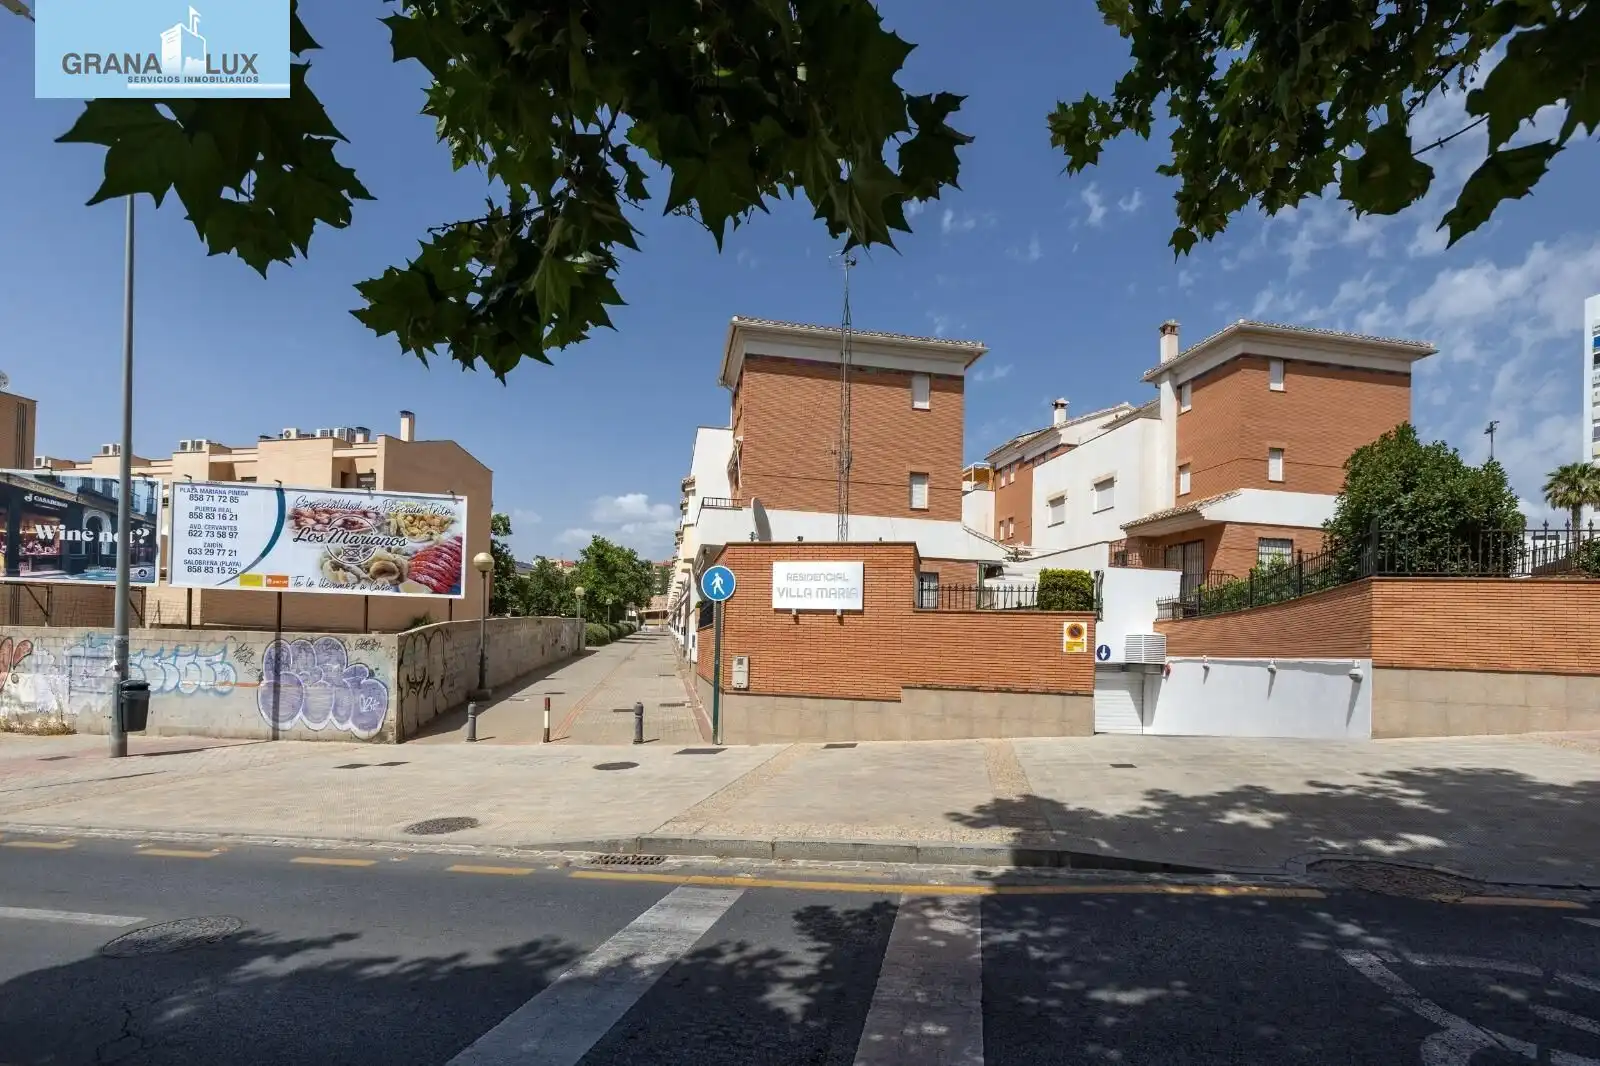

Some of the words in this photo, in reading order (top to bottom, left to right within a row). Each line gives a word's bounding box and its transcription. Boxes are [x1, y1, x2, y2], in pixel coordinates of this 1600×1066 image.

[296, 495, 362, 511] Especialidad
[36, 524, 94, 542] Wine
[205, 530, 214, 538] 73
[293, 527, 324, 542] Los
[328, 527, 408, 547] Marianos
[291, 576, 303, 588] Te
[306, 577, 314, 588] lo
[786, 572, 848, 582] RESIDENCIAL
[776, 587, 812, 599] VILLA
[816, 587, 859, 599] MARIA
